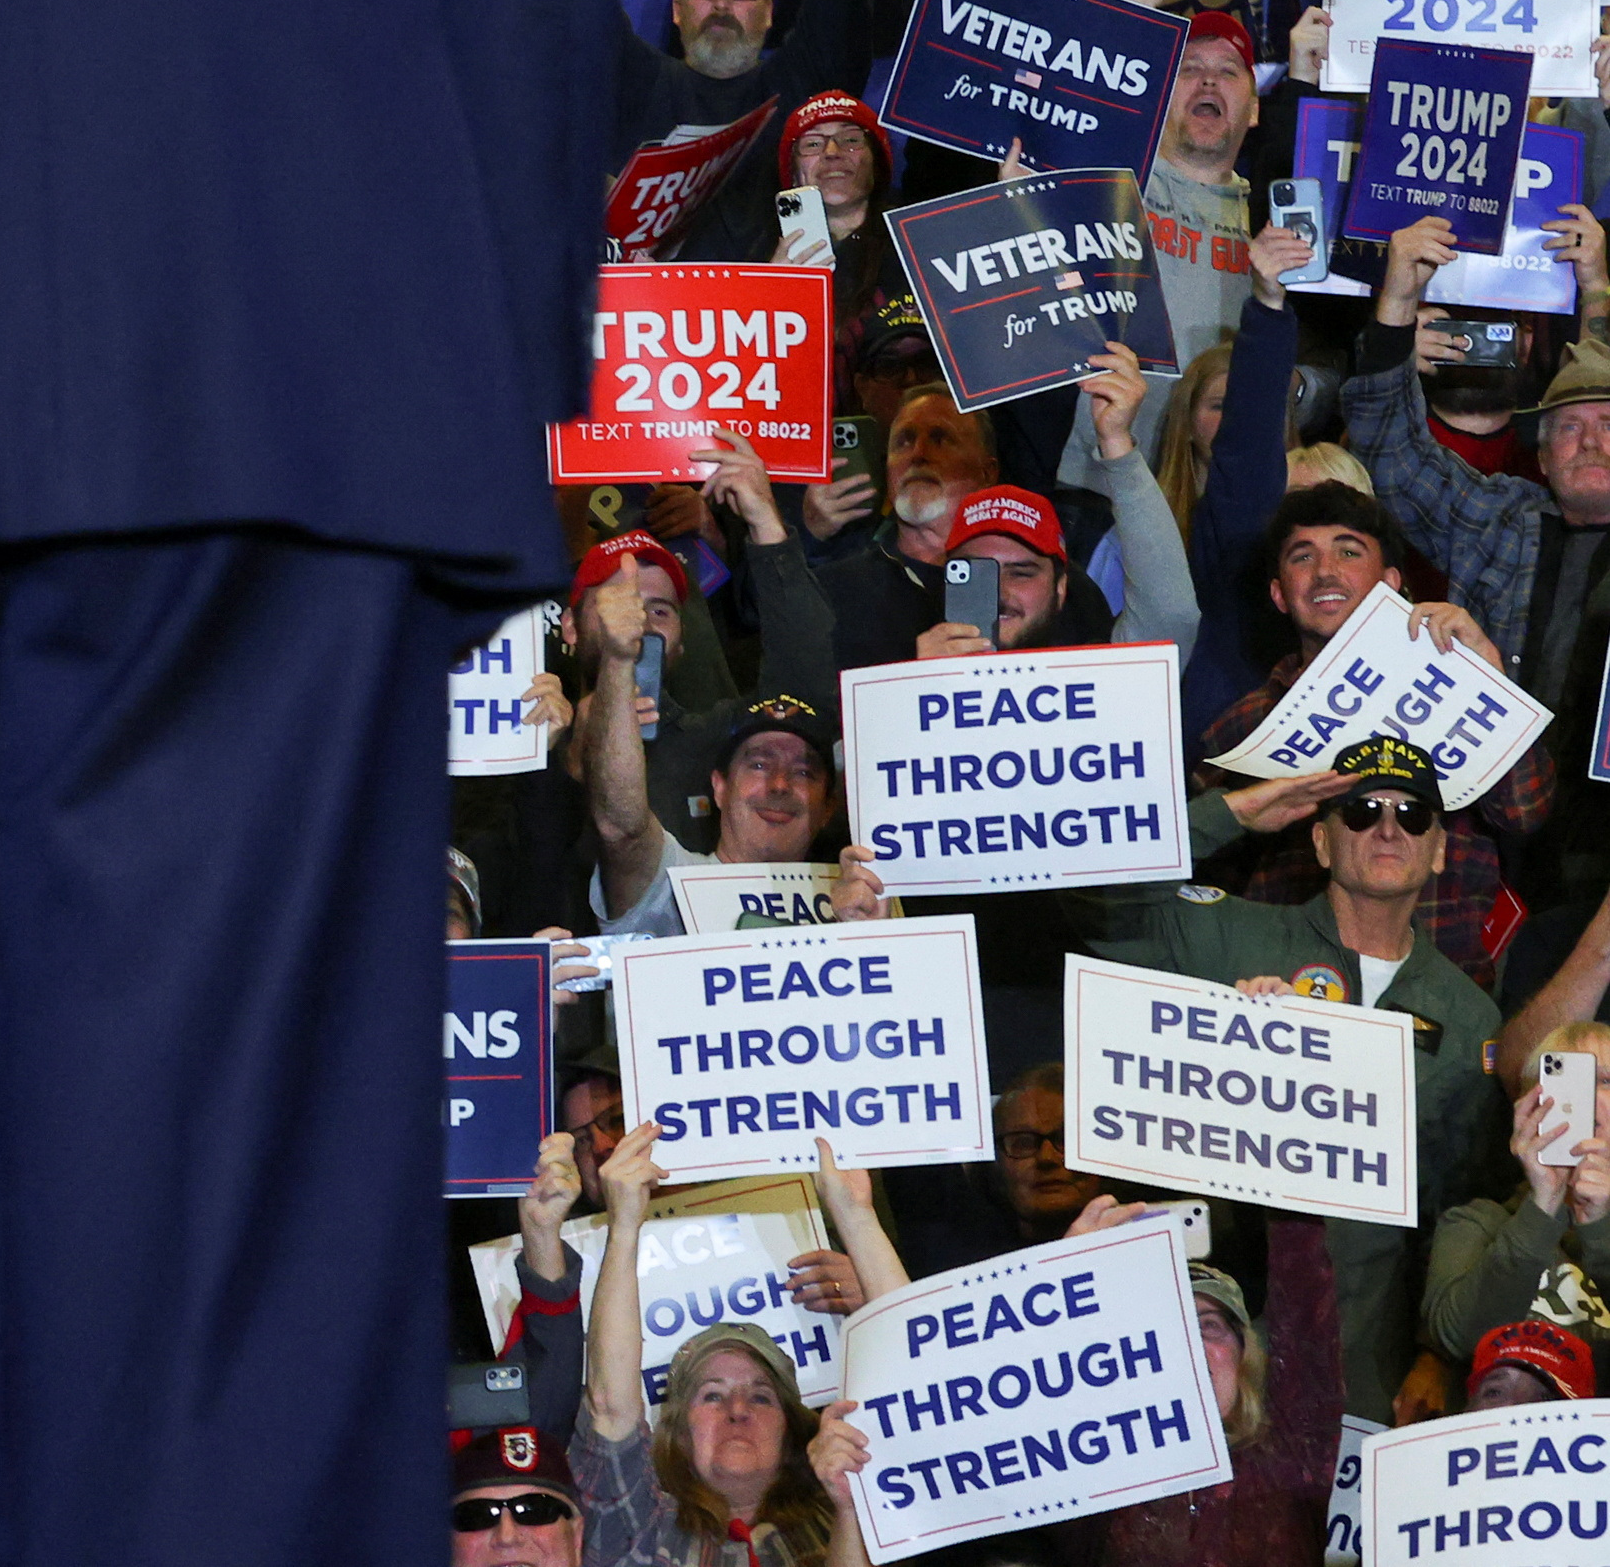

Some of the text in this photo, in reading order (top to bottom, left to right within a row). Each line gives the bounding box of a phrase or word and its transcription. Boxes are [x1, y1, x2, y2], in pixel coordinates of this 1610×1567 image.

[797, 96, 859, 118] TRUMP
[945, 74, 1100, 135] for TRUMP
[1387, 80, 1512, 138] TRUMP
[1395, 132, 1489, 187] 2024
[1370, 183, 1500, 216] TEXT TRUMP TO 88022
[931, 221, 1144, 294] VETERANS
[1004, 289, 1139, 349] for TRUMP
[614, 362, 781, 412] 2024
[577, 419, 812, 441] TEXT TRUMP TO 88022
[963, 497, 1042, 522] MAKE AMERICA
[1001, 509, 1037, 530] AGAIN
[919, 683, 1097, 732] PEACE
[1270, 657, 1385, 770] PEACE
[877, 741, 1146, 799] THROUGH
[1343, 739, 1427, 770] U.S. NAVY
[871, 804, 1162, 861] STRENGTH
[702, 955, 893, 1007] PEACE
[657, 1017, 947, 1076] THROUGH
[1150, 1000, 1332, 1063] PEACE
[653, 1081, 963, 1142] STRENGTH
[1102, 1048, 1378, 1128] THROUGH
[1092, 1104, 1389, 1187] STRENGTH
[906, 1271, 1101, 1359] PEACE
[1491, 1324, 1577, 1362] TRUMP
[864, 1330, 1164, 1439] THROUGH
[876, 1398, 1192, 1511] STRENGTH
